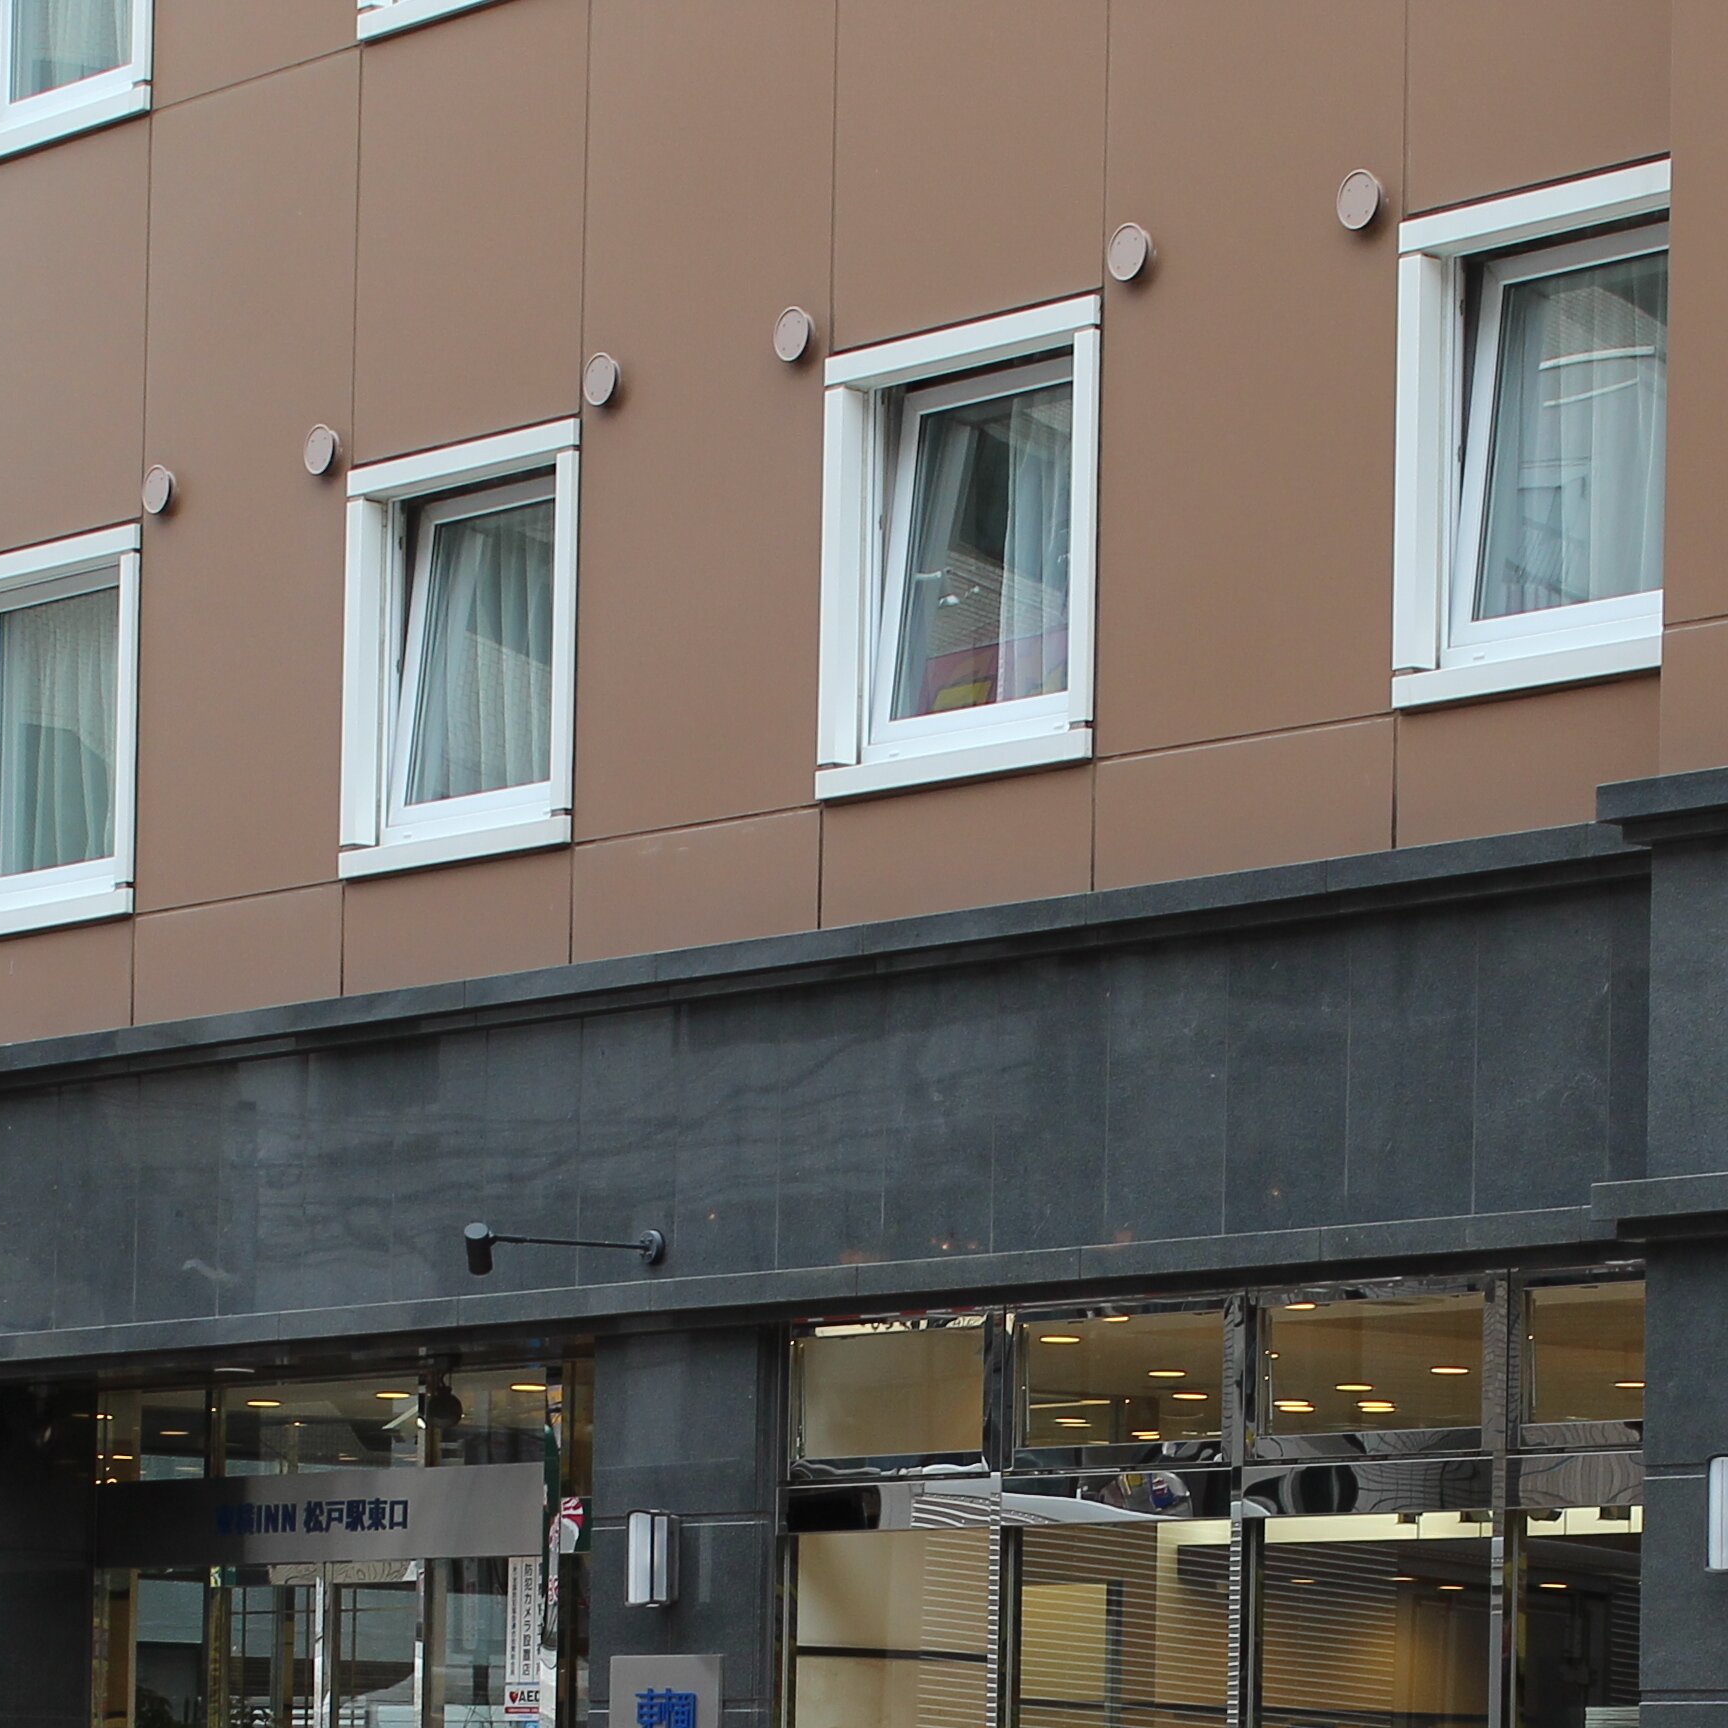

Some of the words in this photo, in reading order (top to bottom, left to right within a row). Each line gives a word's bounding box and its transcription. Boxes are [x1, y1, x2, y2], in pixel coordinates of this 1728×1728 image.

[303, 1497, 409, 1534] 松戸駅東口
[521, 1562, 533, 1677] 防犯カメラ設置店
